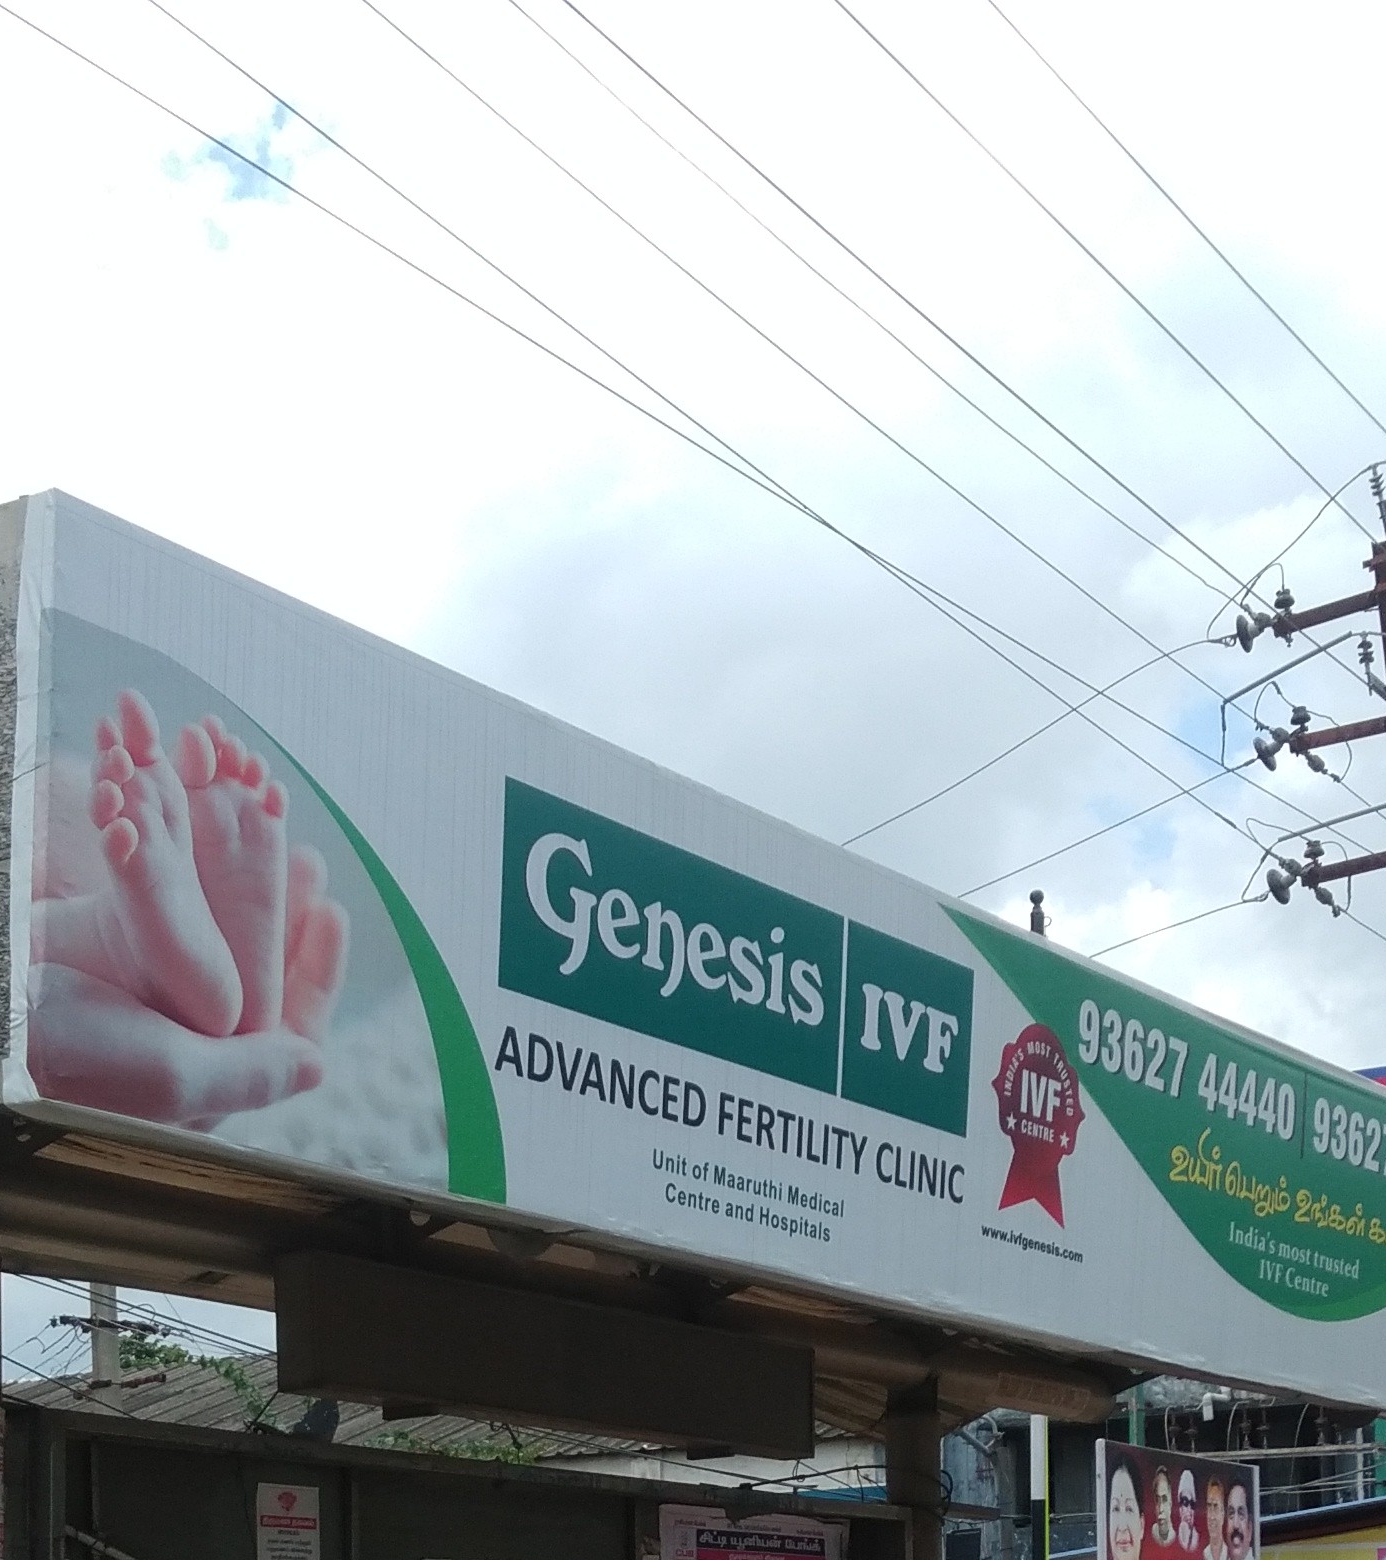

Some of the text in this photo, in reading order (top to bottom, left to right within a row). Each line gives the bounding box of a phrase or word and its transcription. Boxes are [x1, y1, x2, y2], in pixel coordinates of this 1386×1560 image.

[524, 831, 959, 1074] Genesis IVF
[1020, 1068, 1061, 1123] IVF
[1027, 1041, 1051, 1059] MOST
[1053, 1053, 1075, 1117] TRUSTED
[1078, 999, 1296, 1142] 93627 44440
[494, 1025, 967, 1205] ADVANCED FERTILITY CLINIC
[1021, 1118, 1055, 1144] CENTRE
[652, 1147, 845, 1218] Unit of Maaruthi Medical
[665, 1182, 831, 1243] Centre and Hospitals
[1169, 1127, 1223, 1192] உயிர்
[1225, 1161, 1291, 1217] பெறும்
[1294, 1188, 1366, 1237] உங்கள்
[981, 1224, 1084, 1264] www.ivfgenesis.com
[1229, 1221, 1360, 1280] India's most trusted
[1259, 1259, 1330, 1298] IVF Centre
